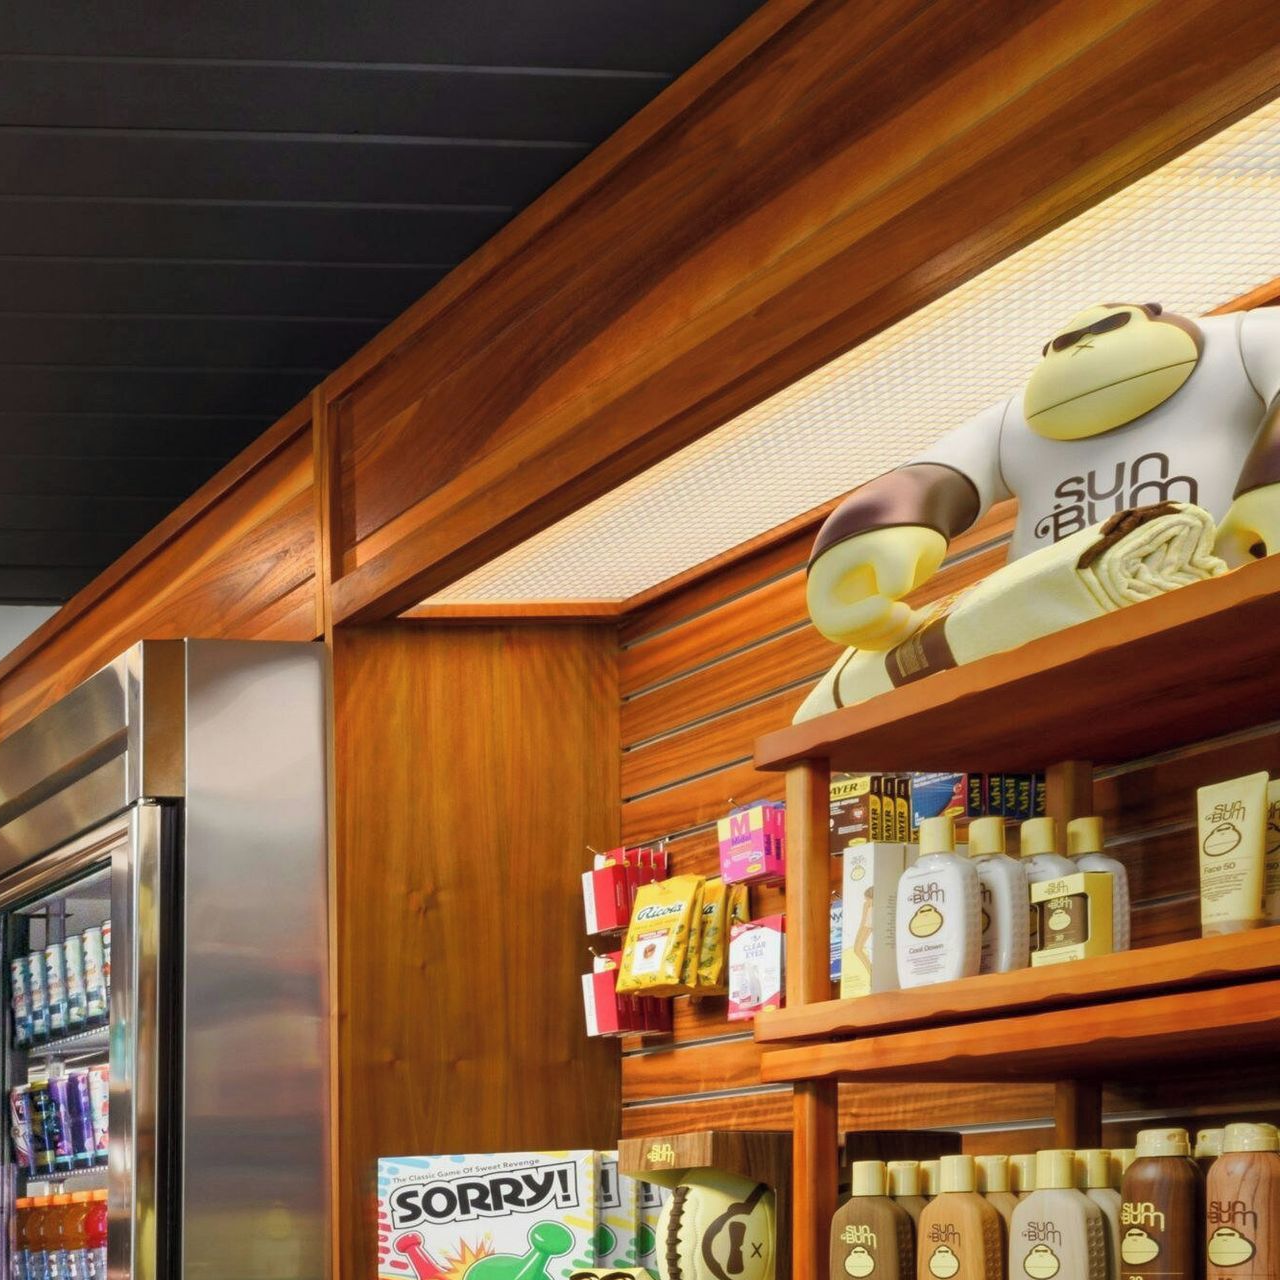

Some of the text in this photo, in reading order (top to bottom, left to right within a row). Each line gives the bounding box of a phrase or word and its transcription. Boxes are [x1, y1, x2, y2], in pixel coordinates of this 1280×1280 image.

[970, 778, 981, 810] Advil
[990, 776, 1002, 808] Advil
[1004, 779, 1016, 809] Advil
[1203, 861, 1236, 874] Face 50
[637, 903, 684, 922] Ricola
[743, 942, 766, 951] CLEAR
[745, 950, 764, 959] EYES
[908, 943, 945, 955] Cool Down
[391, 1158, 540, 1185] The Classic Game Of Sweet Revenge
[395, 1168, 572, 1224] SORRY!
